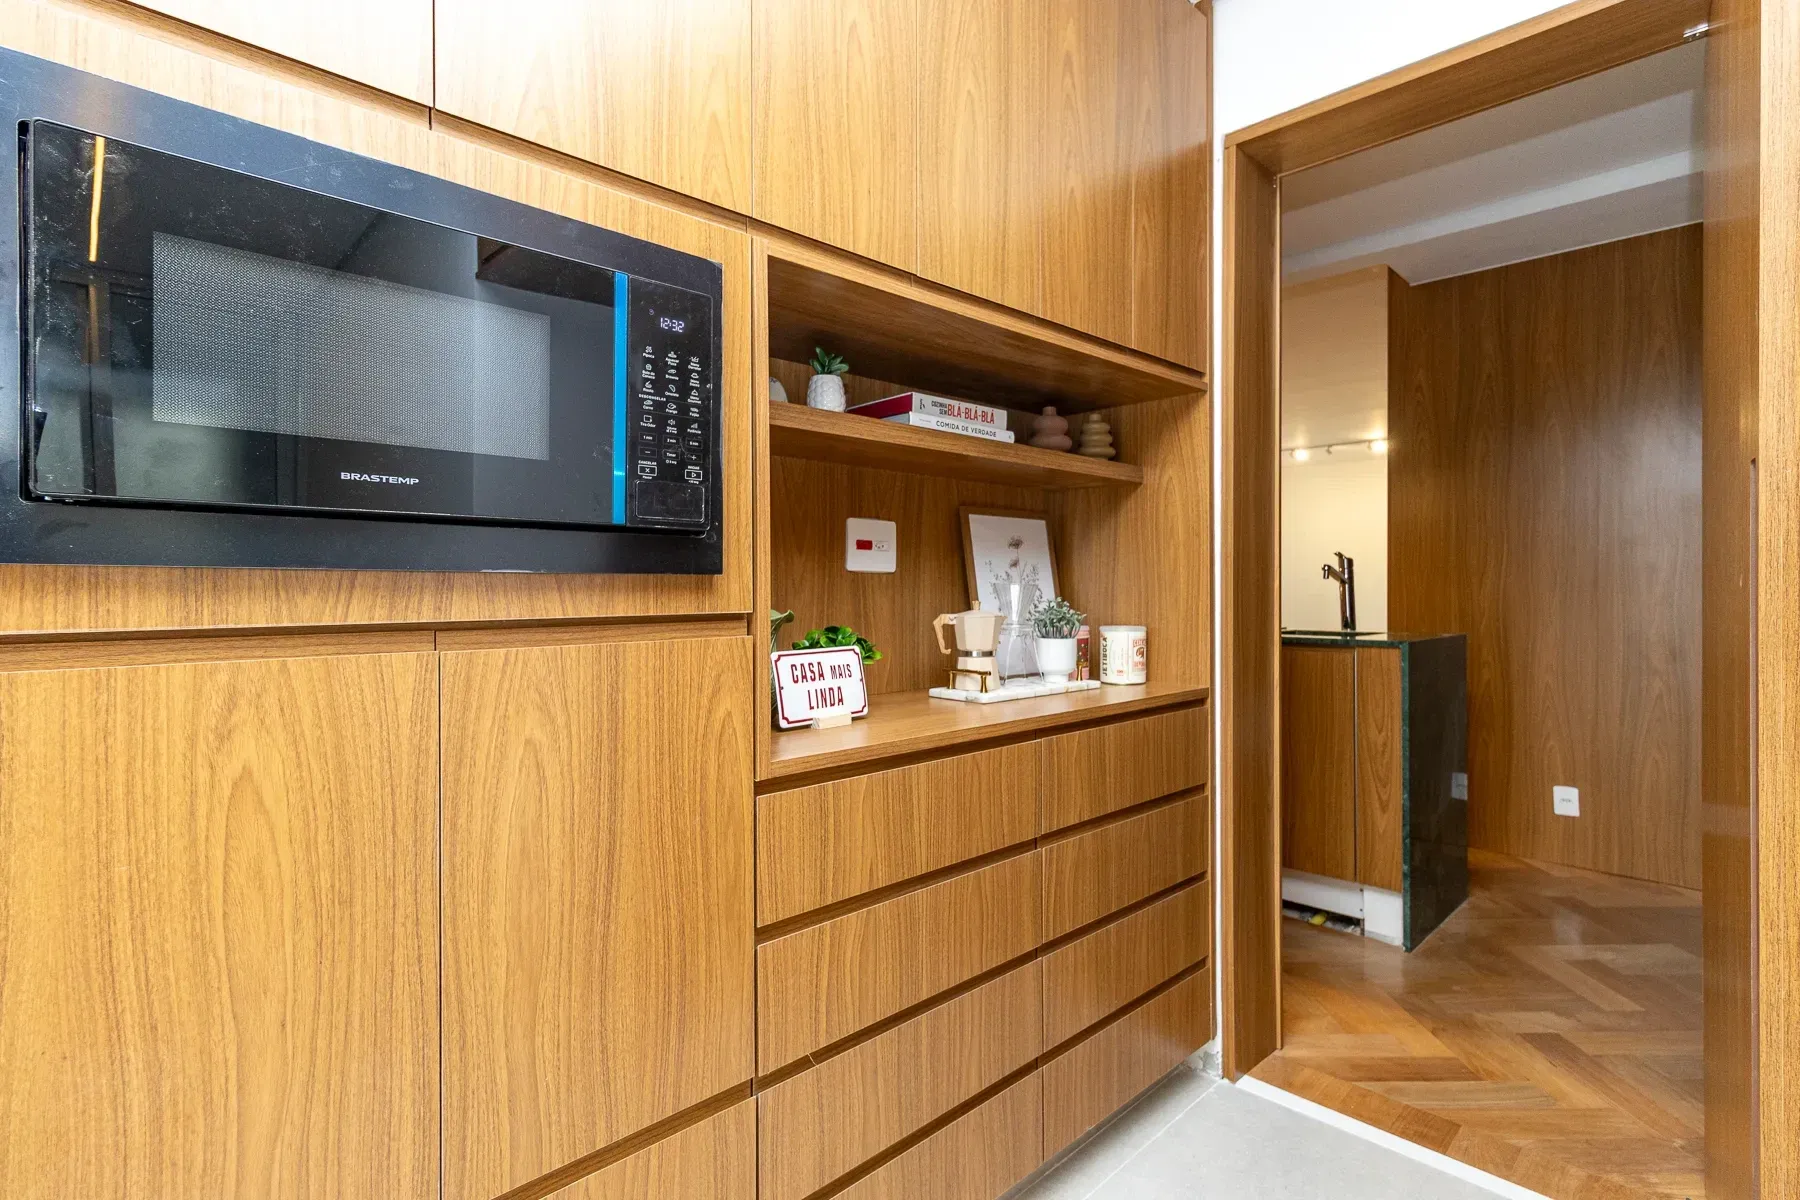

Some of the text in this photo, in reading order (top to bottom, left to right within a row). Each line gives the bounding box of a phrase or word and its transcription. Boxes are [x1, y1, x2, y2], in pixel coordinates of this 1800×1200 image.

[660, 317, 685, 333] 12:32
[638, 393, 667, 402] DESCONGELAR
[939, 408, 948, 416] SEM
[936, 420, 960, 431] COMIDA
[961, 424, 969, 432] DE
[970, 427, 997, 438] VERDADE
[340, 472, 420, 486] BRASTEMP
[790, 661, 853, 685] CASA MAIS
[807, 685, 845, 711] LINDA
